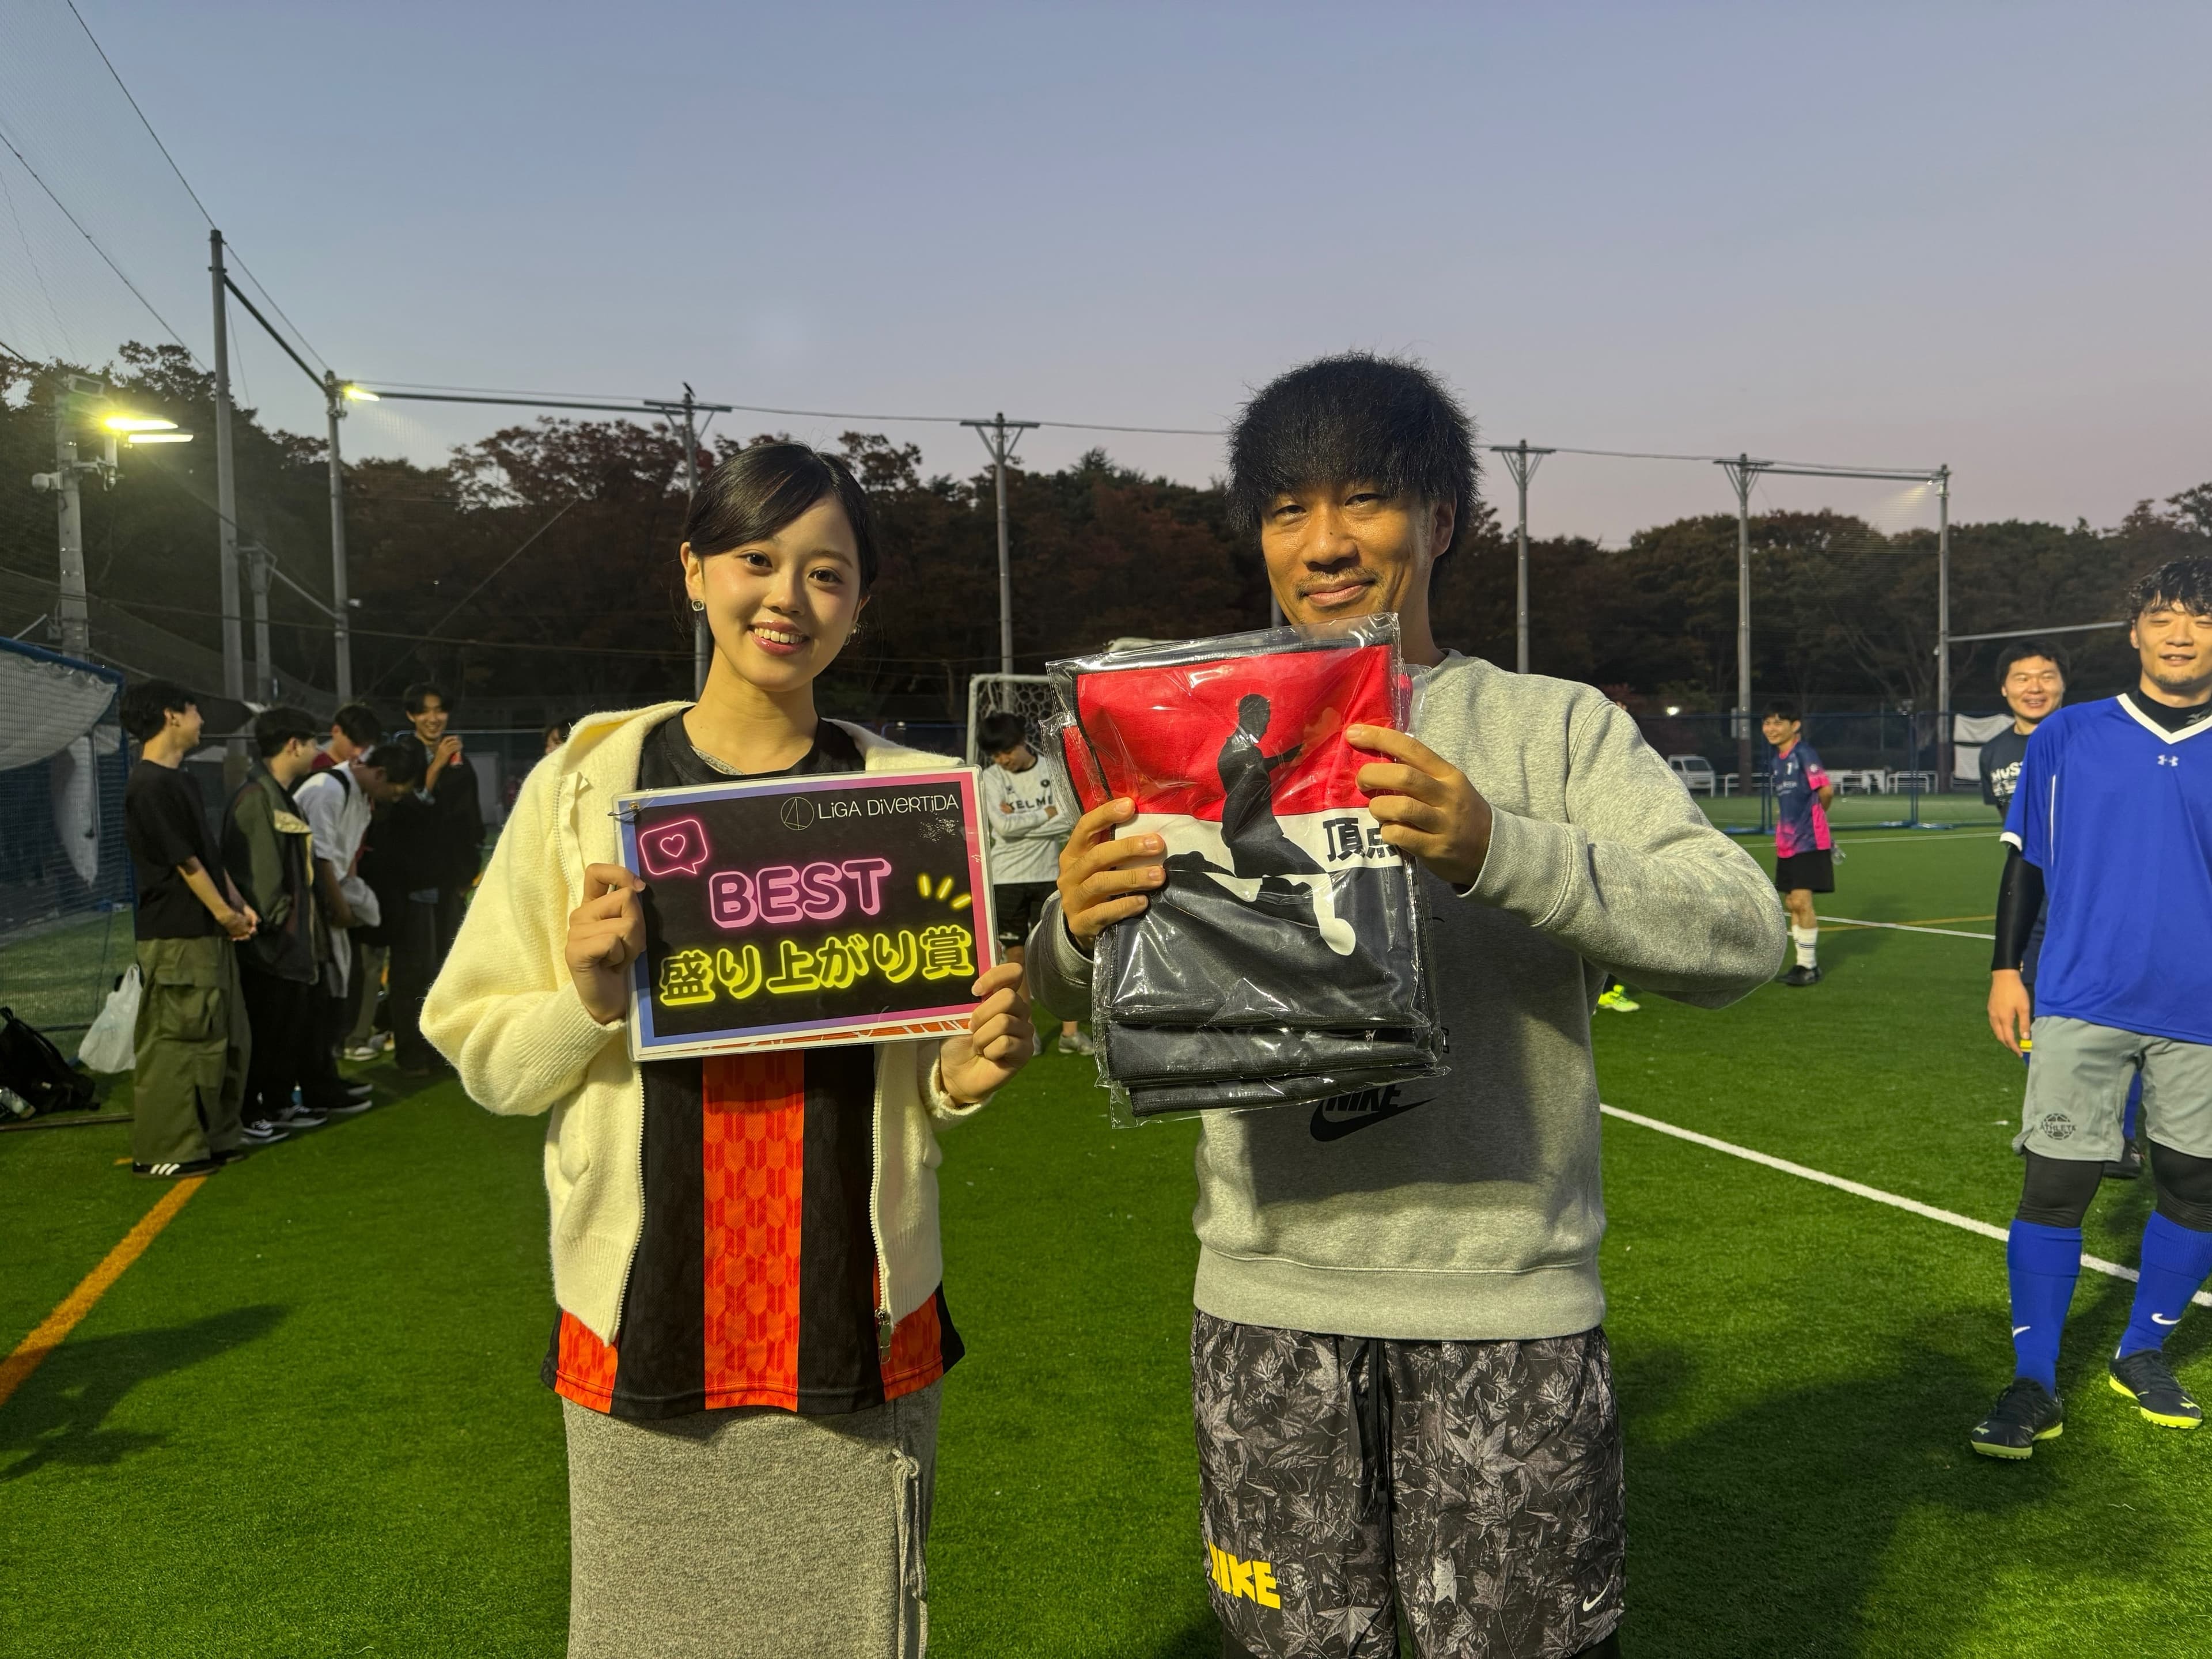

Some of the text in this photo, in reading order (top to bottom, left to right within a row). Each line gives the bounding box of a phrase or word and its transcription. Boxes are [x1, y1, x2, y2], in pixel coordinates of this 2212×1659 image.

[709, 858, 892, 928] BEST
[660, 925, 975, 1006] 盛り上がり賞
